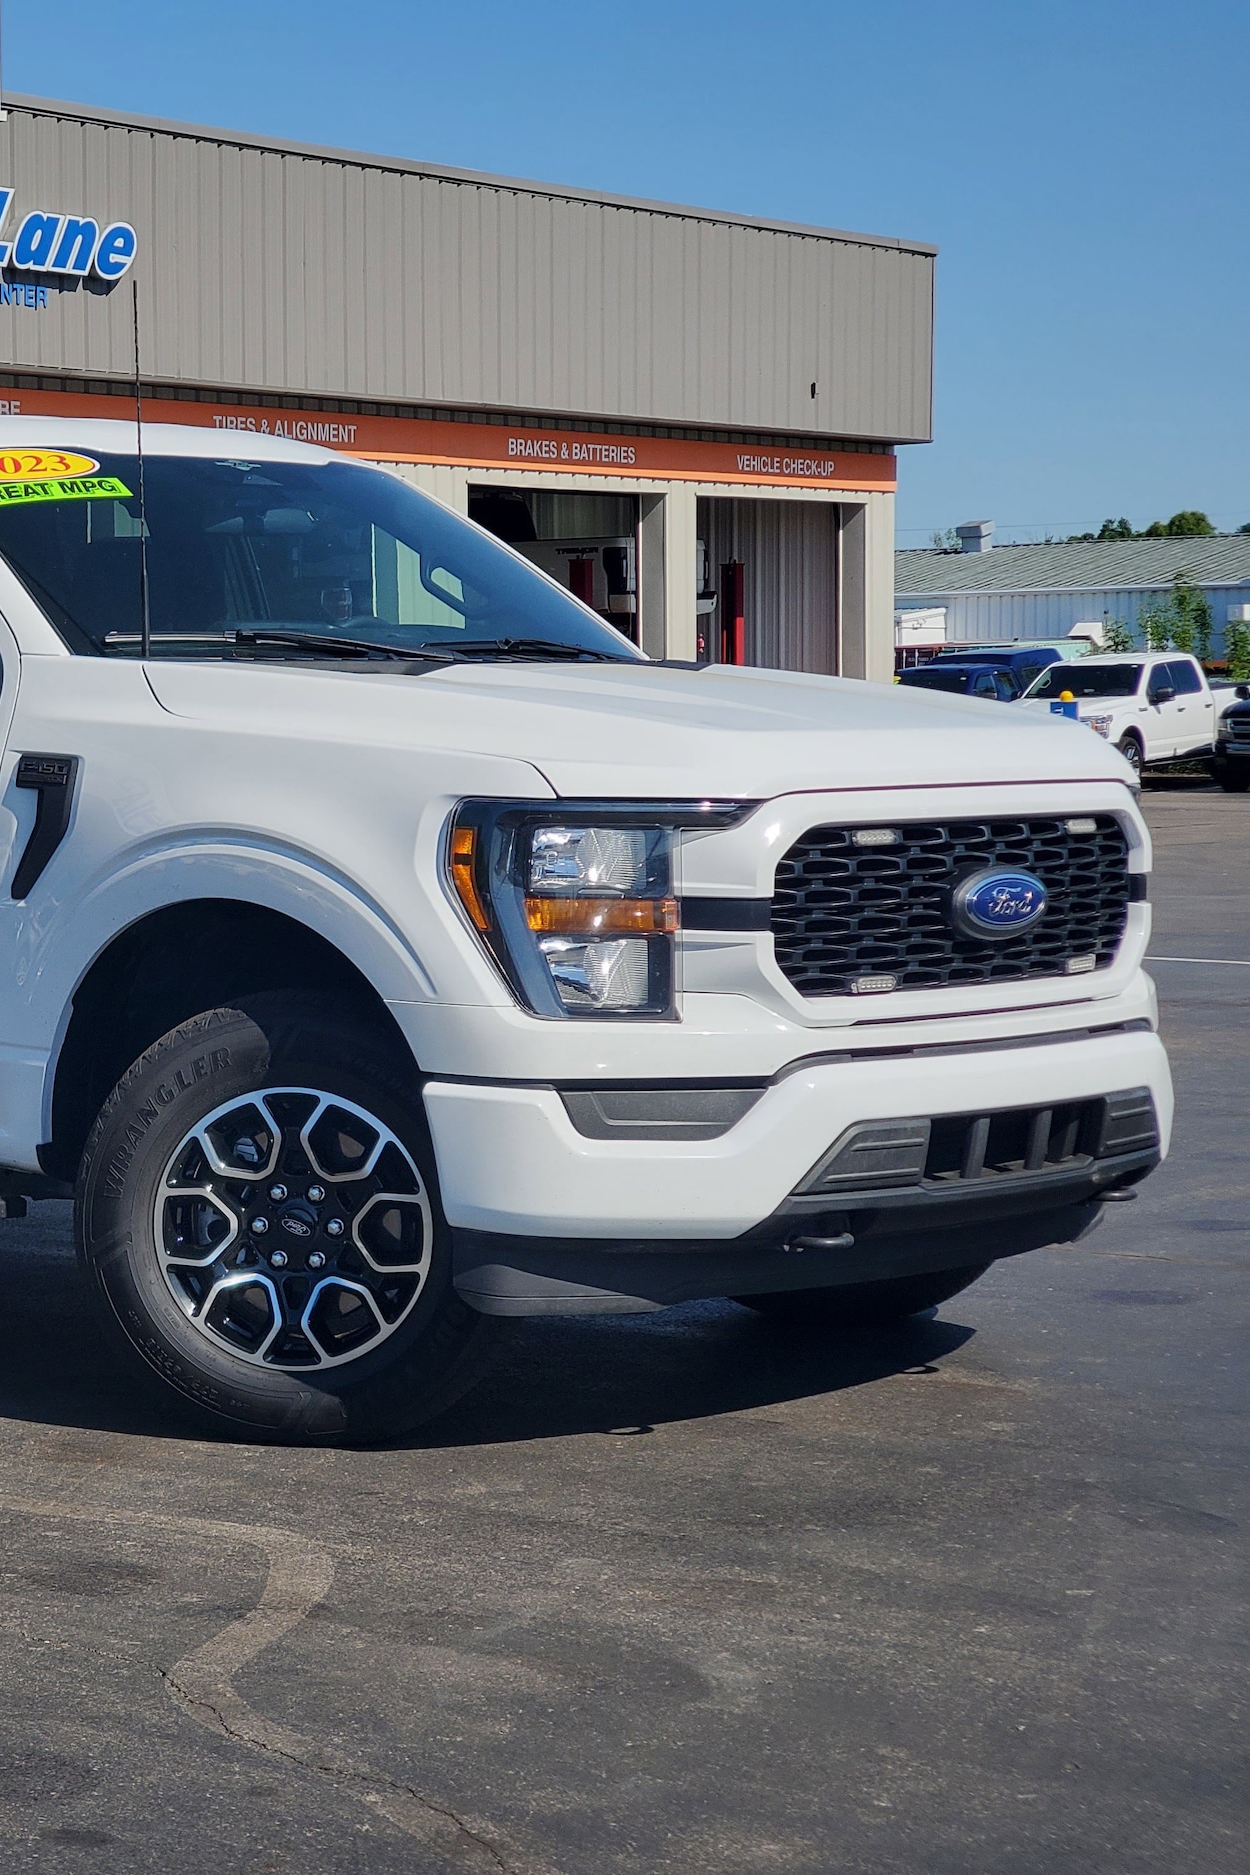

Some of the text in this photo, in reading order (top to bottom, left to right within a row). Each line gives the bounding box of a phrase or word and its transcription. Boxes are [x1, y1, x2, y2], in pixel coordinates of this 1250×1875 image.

[213, 415, 358, 443] TIRES & ALIGNMENT
[508, 438, 636, 464] BRAKES & BATTERIES
[736, 454, 835, 477] VEHICLE CHECK-UP
[62, 478, 120, 497] MPG
[988, 886, 1034, 917] Ford
[103, 1046, 234, 1199] WRANGLER
